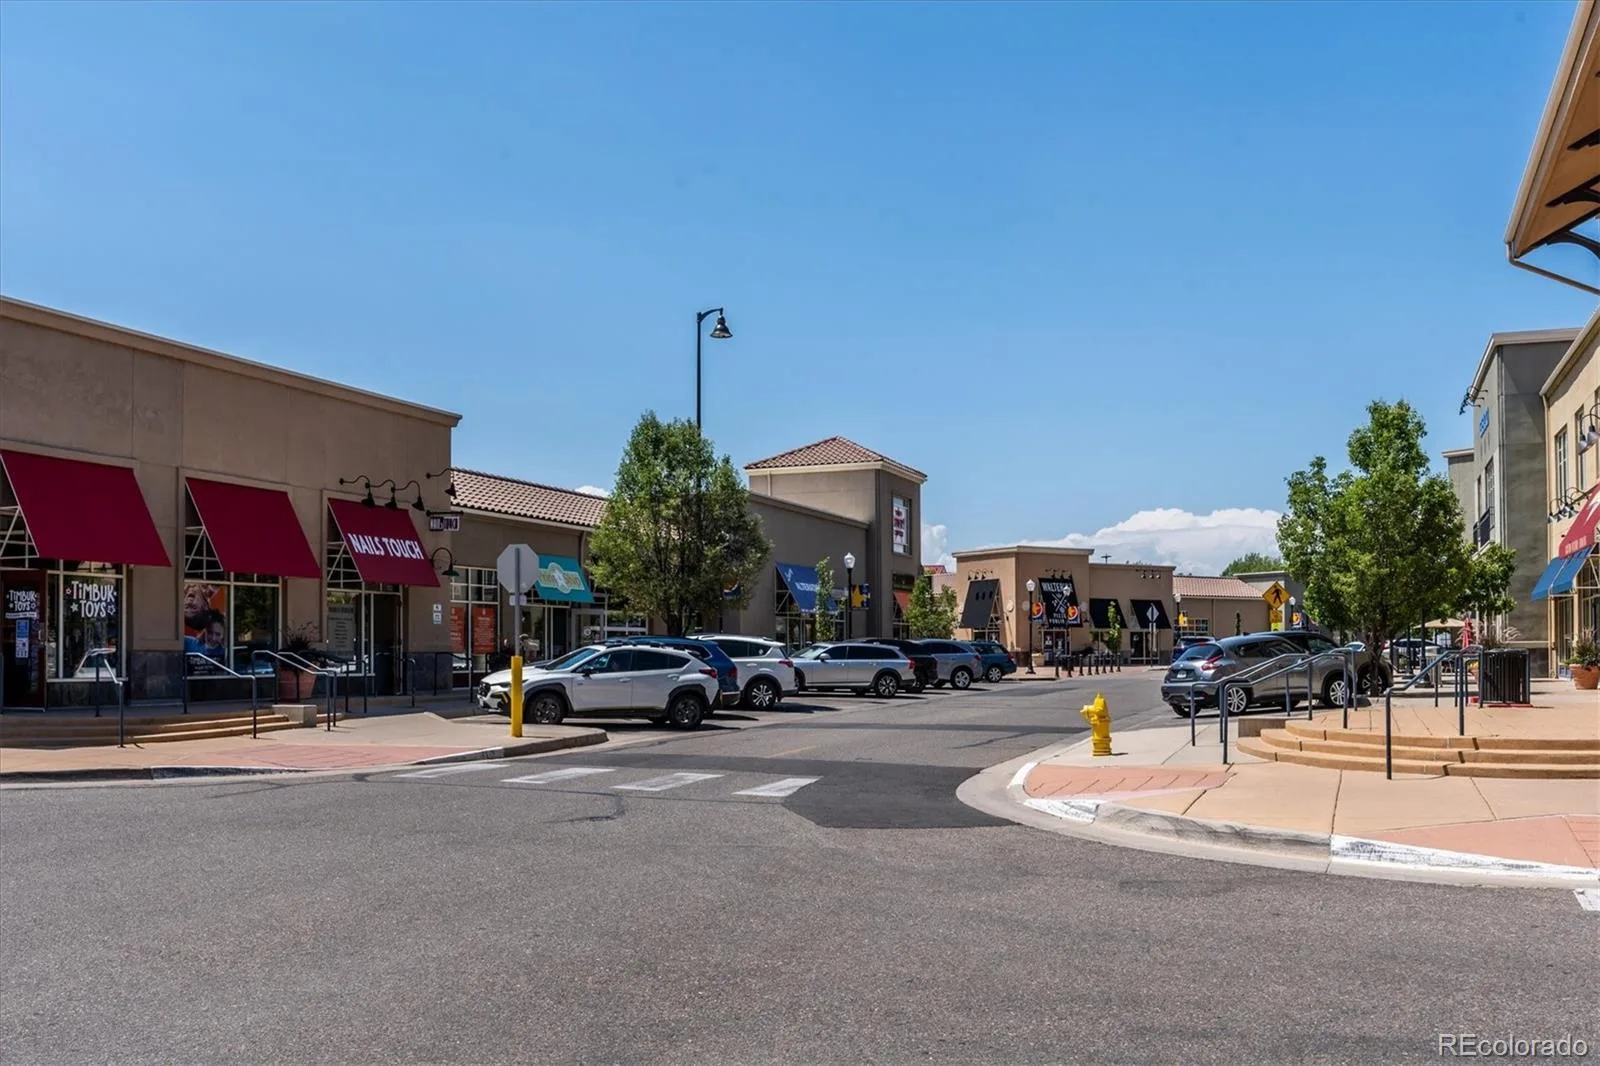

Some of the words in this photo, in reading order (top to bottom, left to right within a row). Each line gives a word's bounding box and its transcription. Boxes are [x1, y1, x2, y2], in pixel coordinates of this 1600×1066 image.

[348, 533, 385, 556] NAILS
[382, 537, 424, 560] TOUCH
[14, 601, 31, 611] TOYS
[80, 600, 106, 617] TOYS
